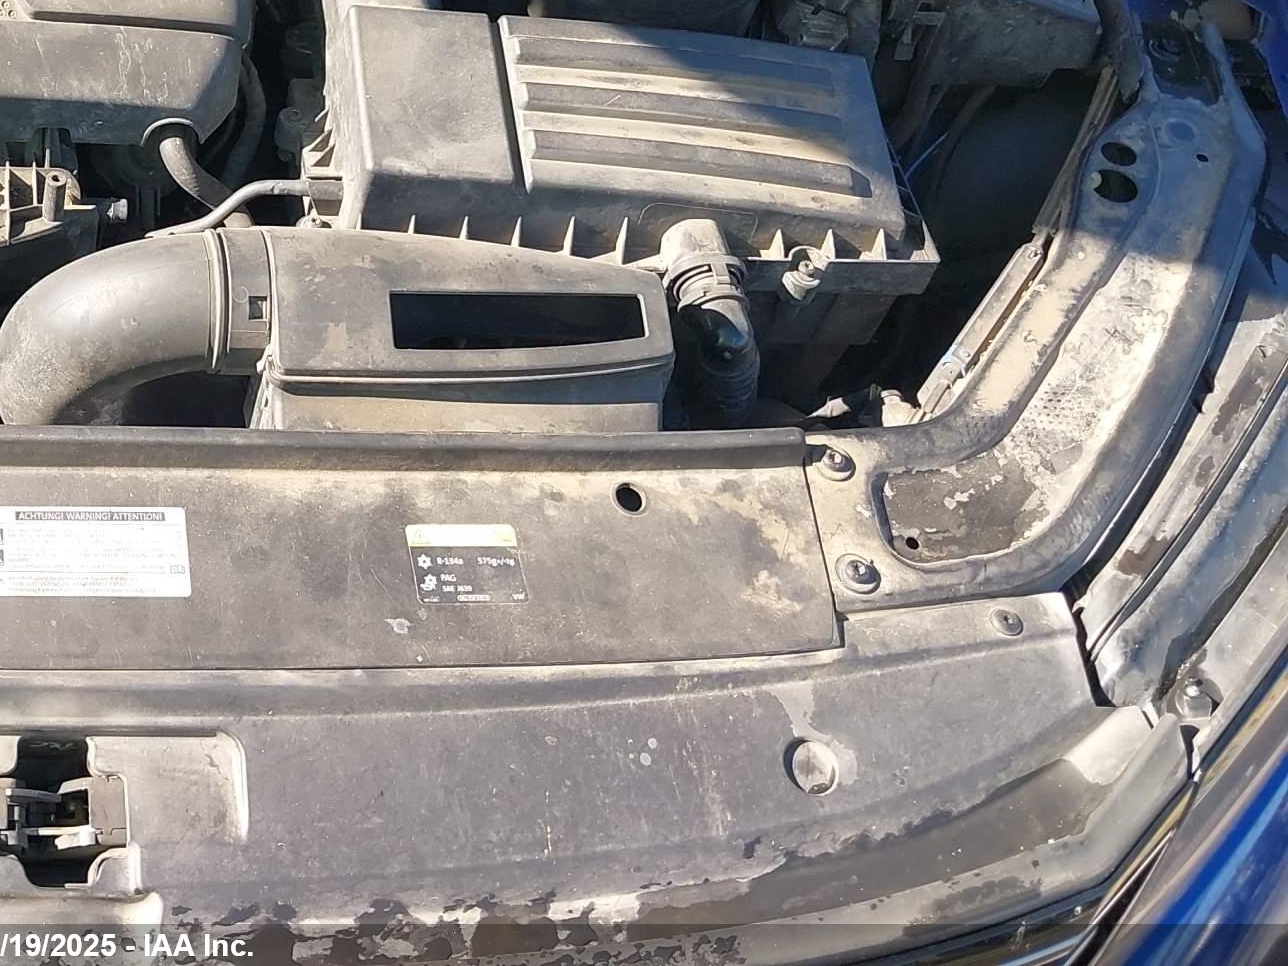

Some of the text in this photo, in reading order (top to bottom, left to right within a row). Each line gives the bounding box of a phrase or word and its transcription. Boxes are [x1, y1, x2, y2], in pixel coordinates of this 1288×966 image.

[18, 512, 163, 522] ACHTUNG! WARNING! ATTENTION!
[440, 574, 457, 582] PAG
